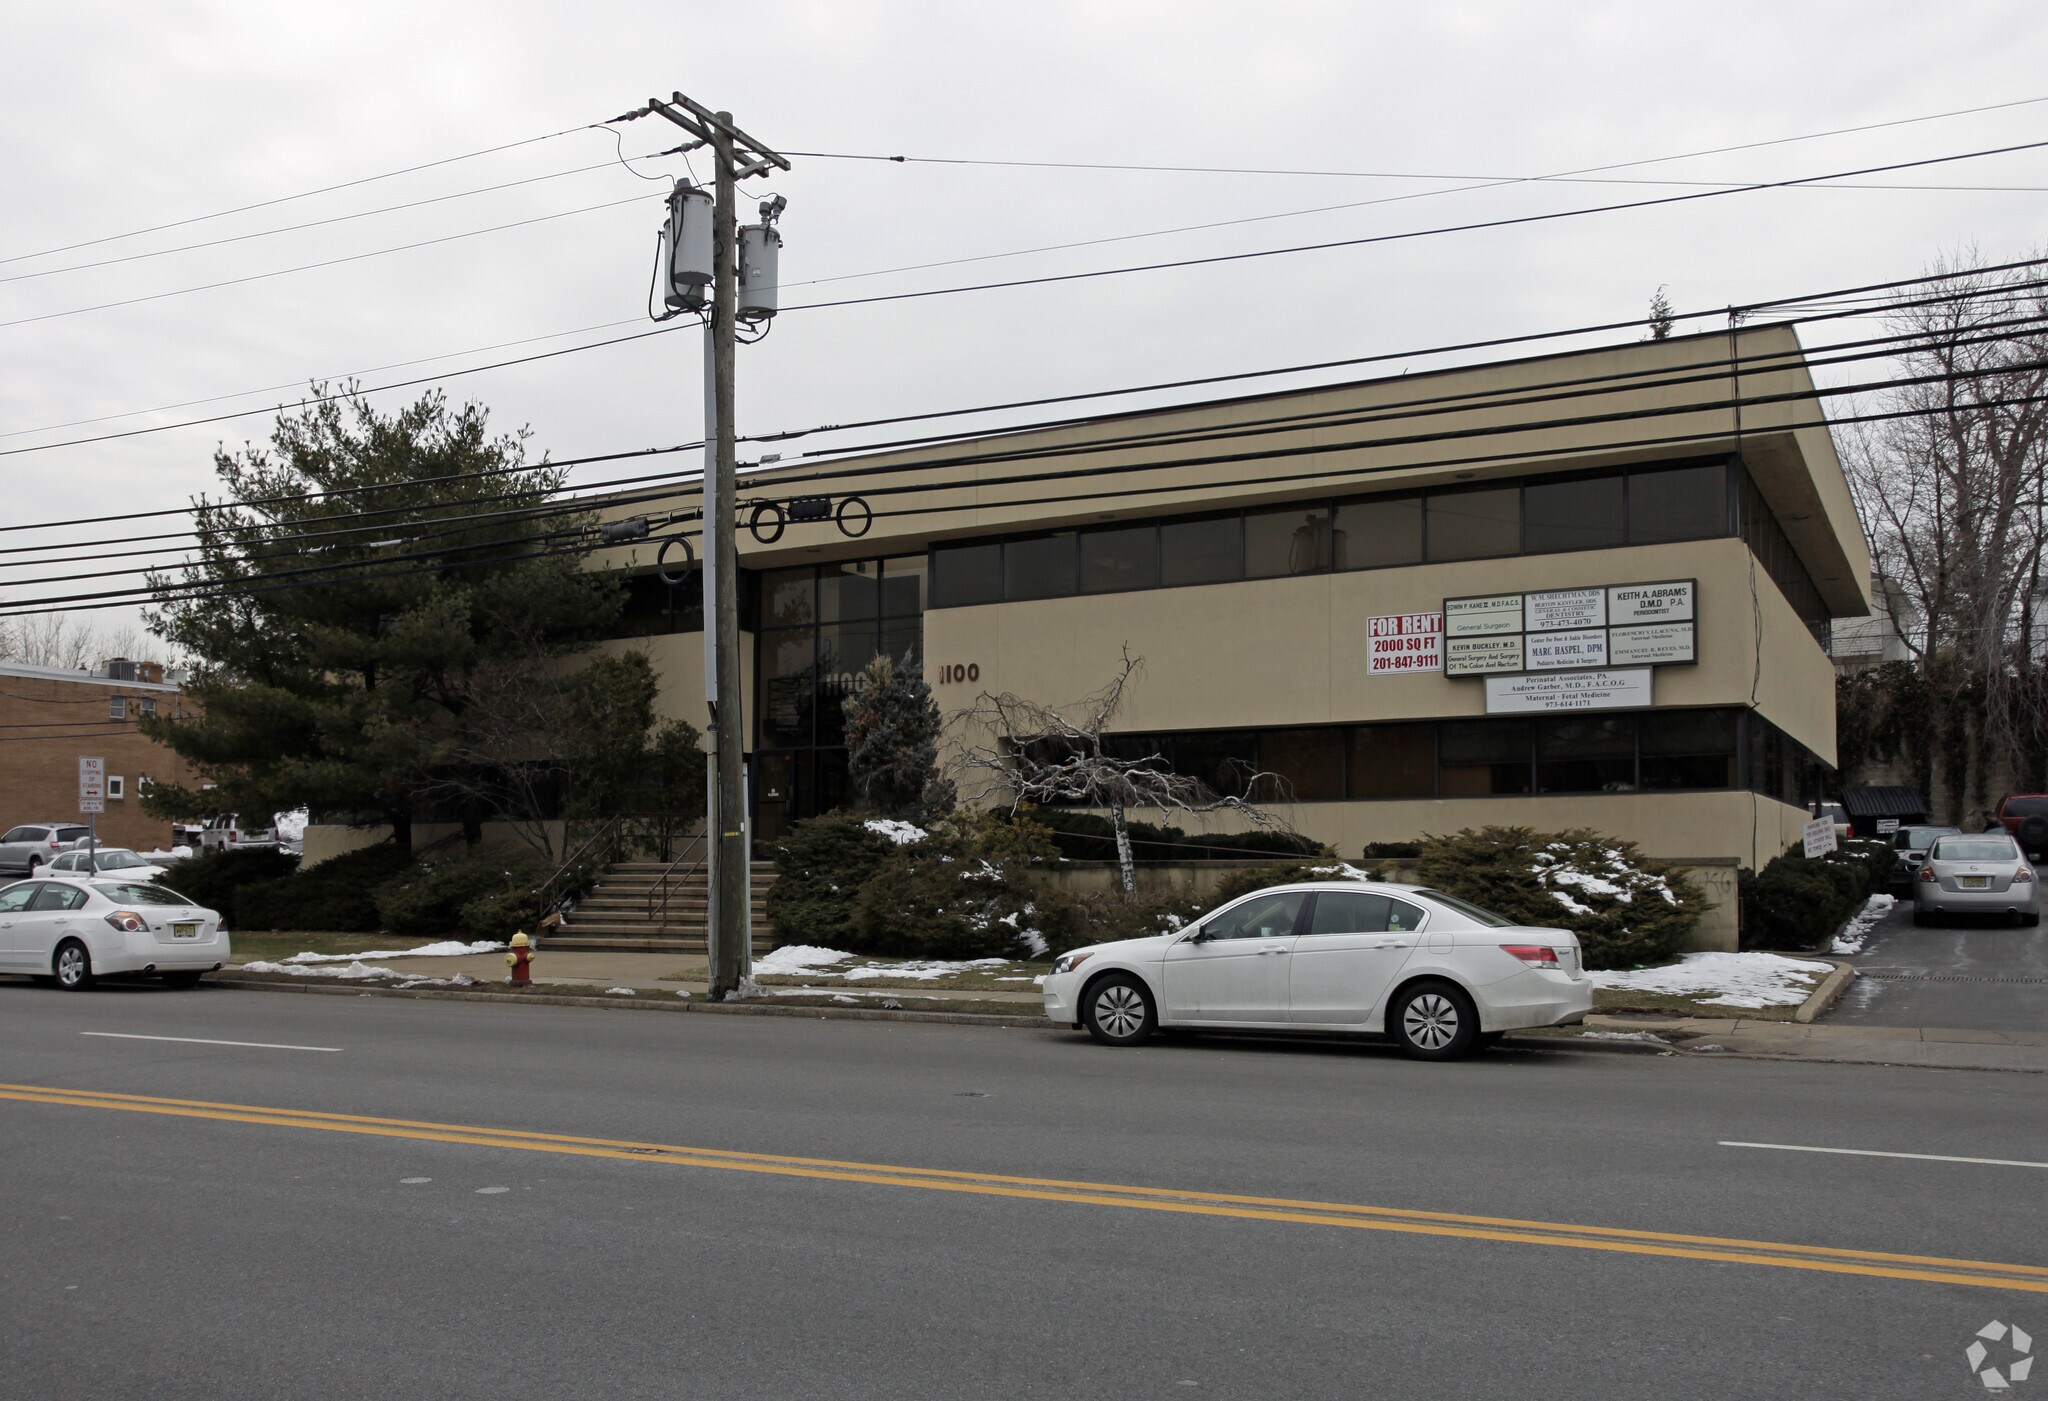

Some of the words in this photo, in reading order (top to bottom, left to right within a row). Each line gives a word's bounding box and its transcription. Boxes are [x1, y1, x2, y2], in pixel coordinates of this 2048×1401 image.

[1618, 592, 1640, 600] KEITH
[1652, 588, 1687, 598] ABRAMS
[1370, 617, 1398, 636] FOR
[1402, 614, 1440, 633] RENT
[1540, 618, 1591, 627] 973-473-4070
[1375, 639, 1403, 652] 2000
[1407, 638, 1421, 650] SQ
[1424, 637, 1436, 649] FT
[1532, 647, 1552, 656] MARC
[1555, 645, 1584, 655] HASPEL,
[1587, 644, 1602, 652] DPM
[1373, 654, 1438, 669] 201-847-9111
